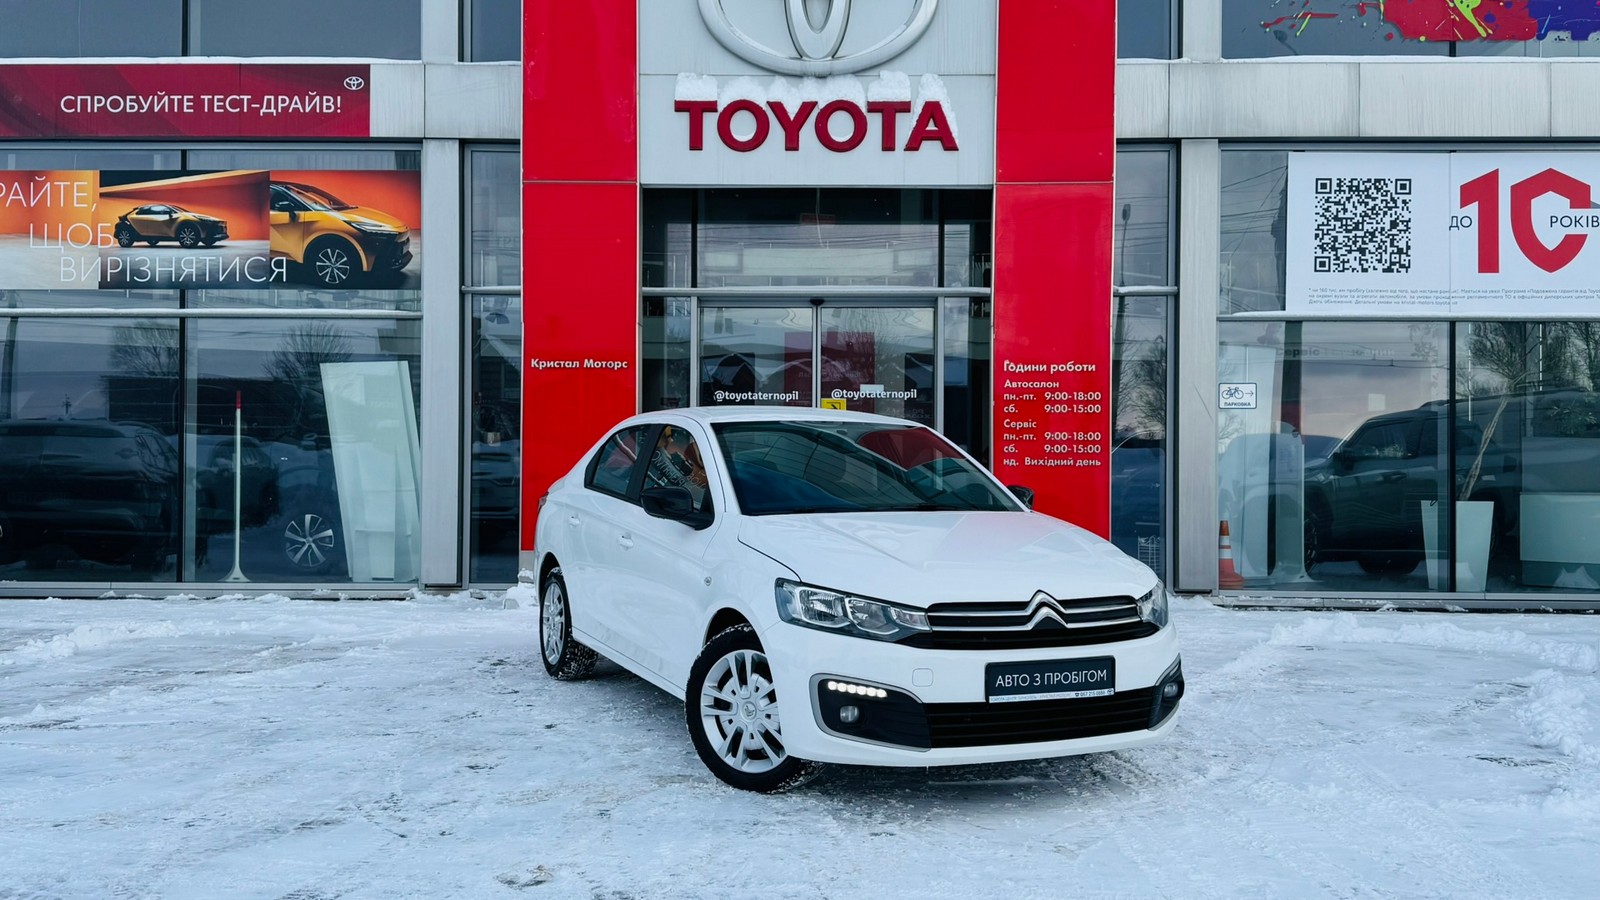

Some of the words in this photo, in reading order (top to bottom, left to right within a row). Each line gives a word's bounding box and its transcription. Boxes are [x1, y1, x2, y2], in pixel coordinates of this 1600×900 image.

[60, 91, 194, 114] СПРОБУЙТЕ
[200, 91, 342, 117] ТЕСТ-ДРАЙВ!
[674, 99, 960, 153] TOYOTA
[1449, 216, 1472, 231] ДО
[1550, 216, 1600, 228] РОКІВ
[30, 223, 114, 254] ЩОБ
[61, 256, 287, 282] ВИРІЗНЯТИСЯ
[530, 359, 580, 370] Кристал
[583, 359, 628, 370] Моторс
[1003, 360, 1047, 373] Години
[1050, 361, 1096, 374] роботи
[1004, 379, 1060, 388] Автосалон
[714, 391, 799, 402] @toyotaternopil
[831, 388, 917, 399] @toyotaternopil
[1044, 391, 1101, 400] 9:00-18:00
[1003, 403, 1019, 413] сб.
[1044, 404, 1101, 413] 9:00-15:00
[1003, 418, 1037, 430] Сервіс
[1003, 433, 1037, 441] пн.-пт.
[1044, 431, 1101, 441] 9:00-18:00
[1003, 443, 1019, 453] сб.
[1044, 444, 1101, 453] 9:00-15:00
[1003, 458, 1019, 467] нд.
[1024, 456, 1074, 467] Вихідний
[1076, 459, 1101, 467] день
[995, 674, 1030, 688] АВТО
[1044, 669, 1107, 685] ПРОБІГОМ
